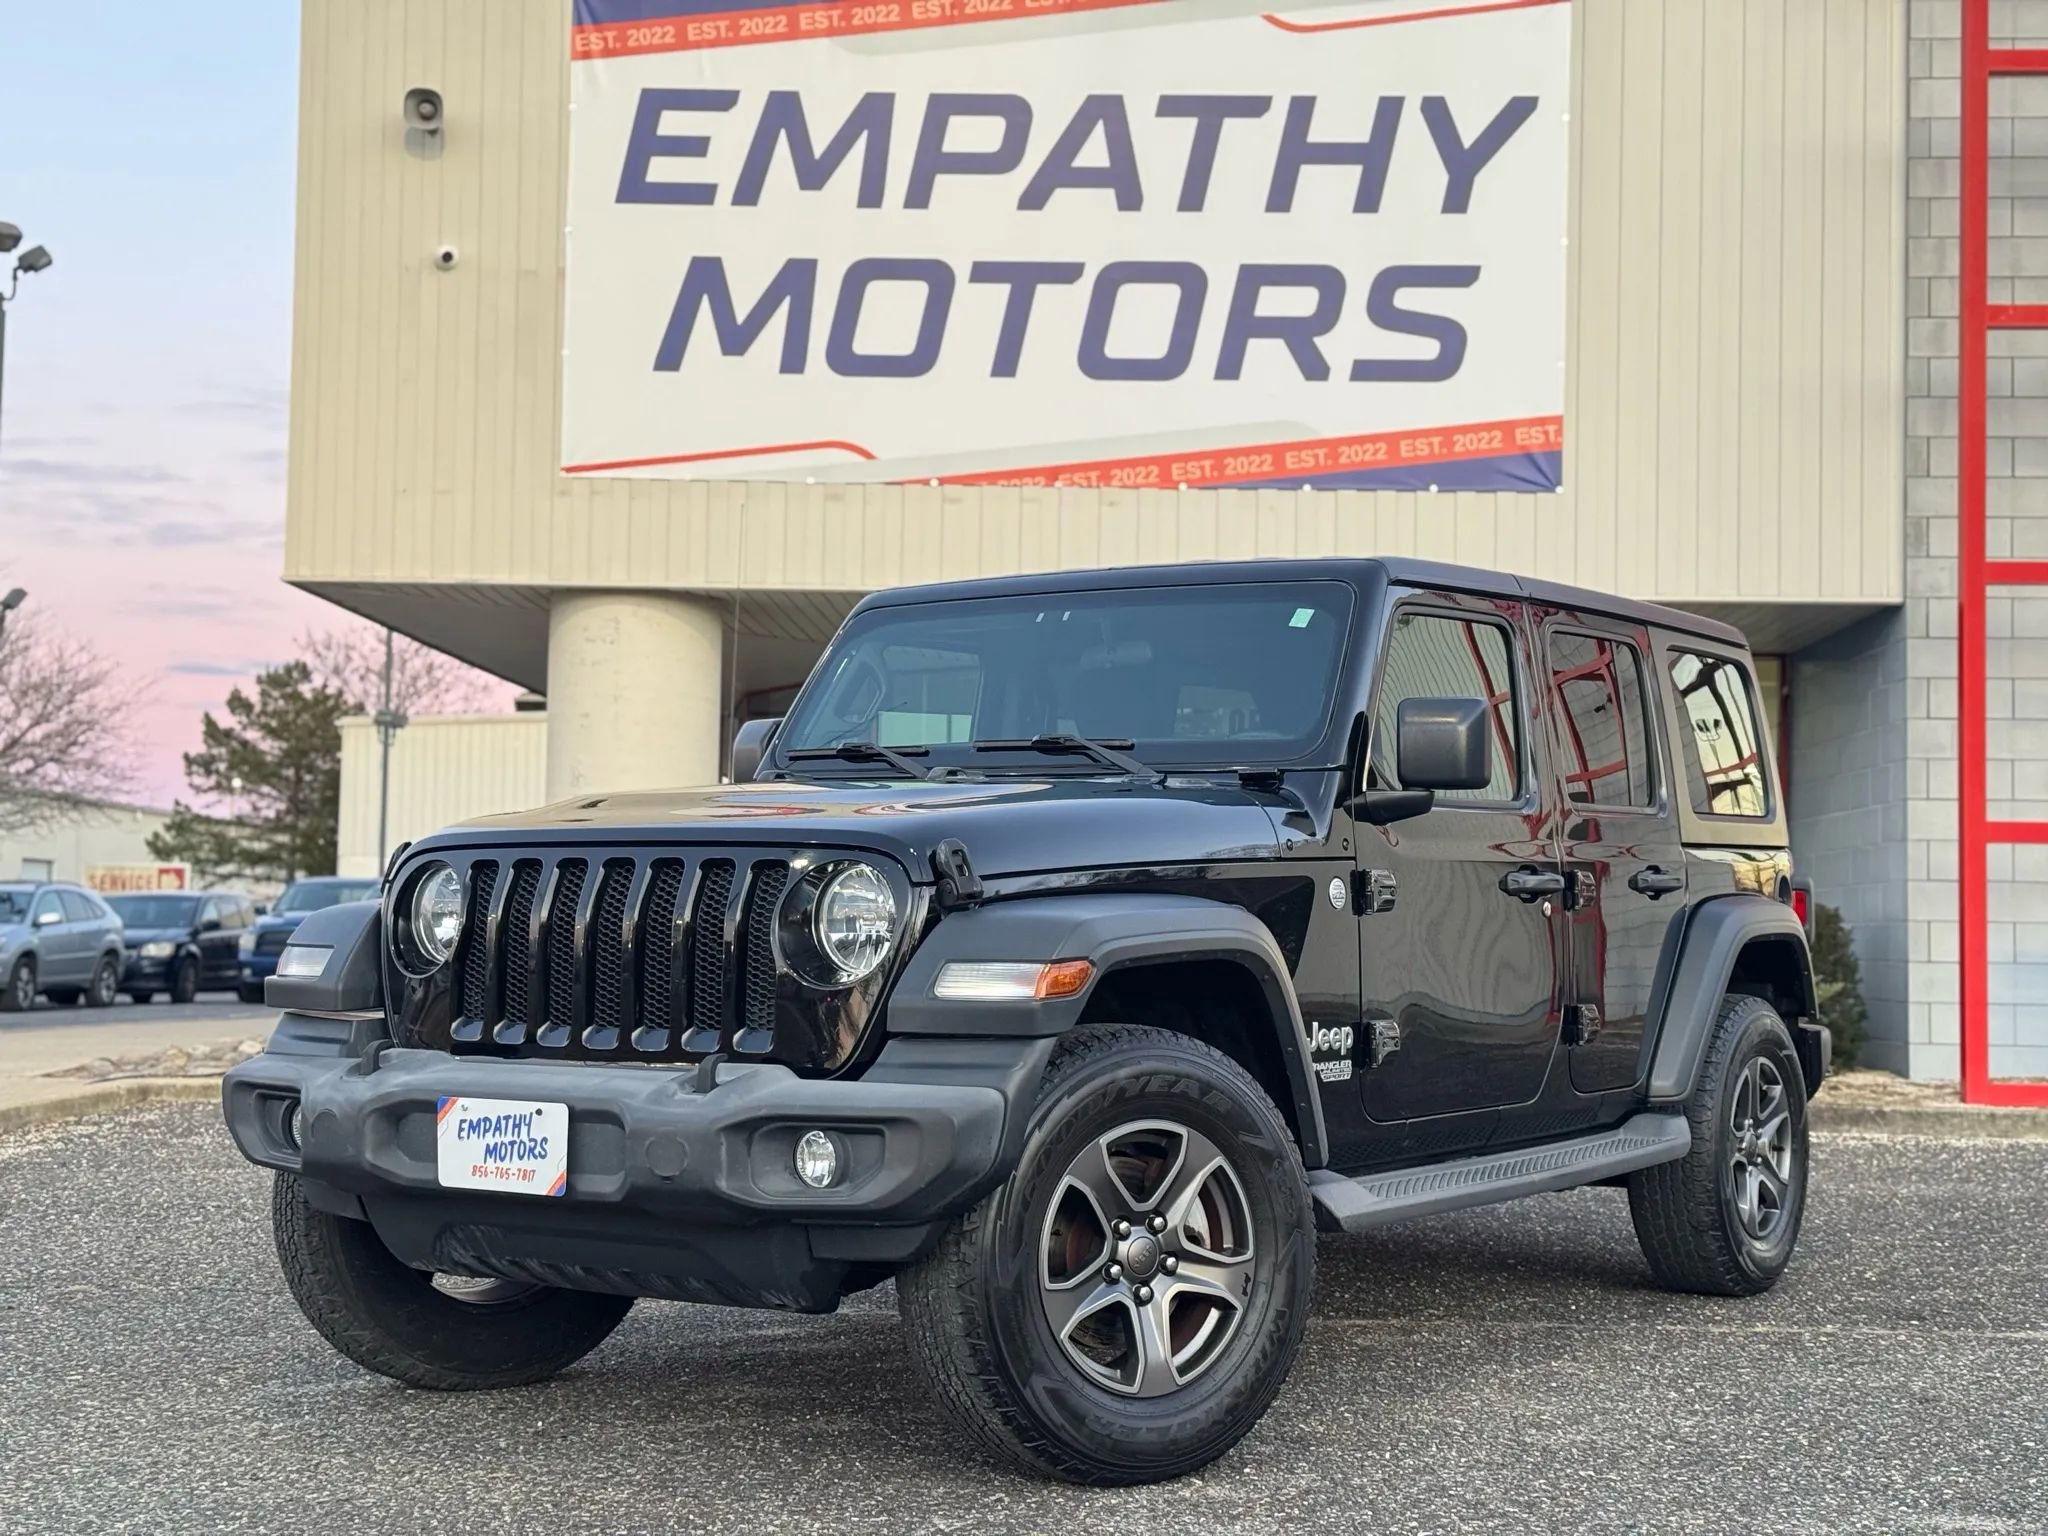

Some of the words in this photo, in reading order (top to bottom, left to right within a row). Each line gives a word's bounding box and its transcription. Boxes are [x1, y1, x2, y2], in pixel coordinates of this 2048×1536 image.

[575, 30, 621, 52] EST.
[627, 26, 675, 47] 2022
[687, 20, 734, 42] EST.
[740, 16, 788, 38] 2022
[800, 10, 847, 32] EST.
[852, 5, 901, 27] 2022
[912, 0, 959, 21] EST.
[615, 88, 1540, 214] EMPATHY
[653, 256, 1482, 383] MOTORS
[1111, 465, 1160, 486] 2022
[1171, 459, 1218, 481] EST.
[1224, 453, 1274, 475] 2022
[1285, 447, 1332, 469] EST.
[1338, 441, 1388, 464] 2022
[1400, 436, 1448, 458] EST.
[1453, 430, 1504, 452] 2022
[1514, 424, 1562, 446] EST.
[1307, 1021, 1354, 1056] Jeep
[457, 1112, 533, 1141] EMPATHY
[483, 1136, 549, 1165] MOTORS
[471, 1165, 537, 1183] 856-765-7817
